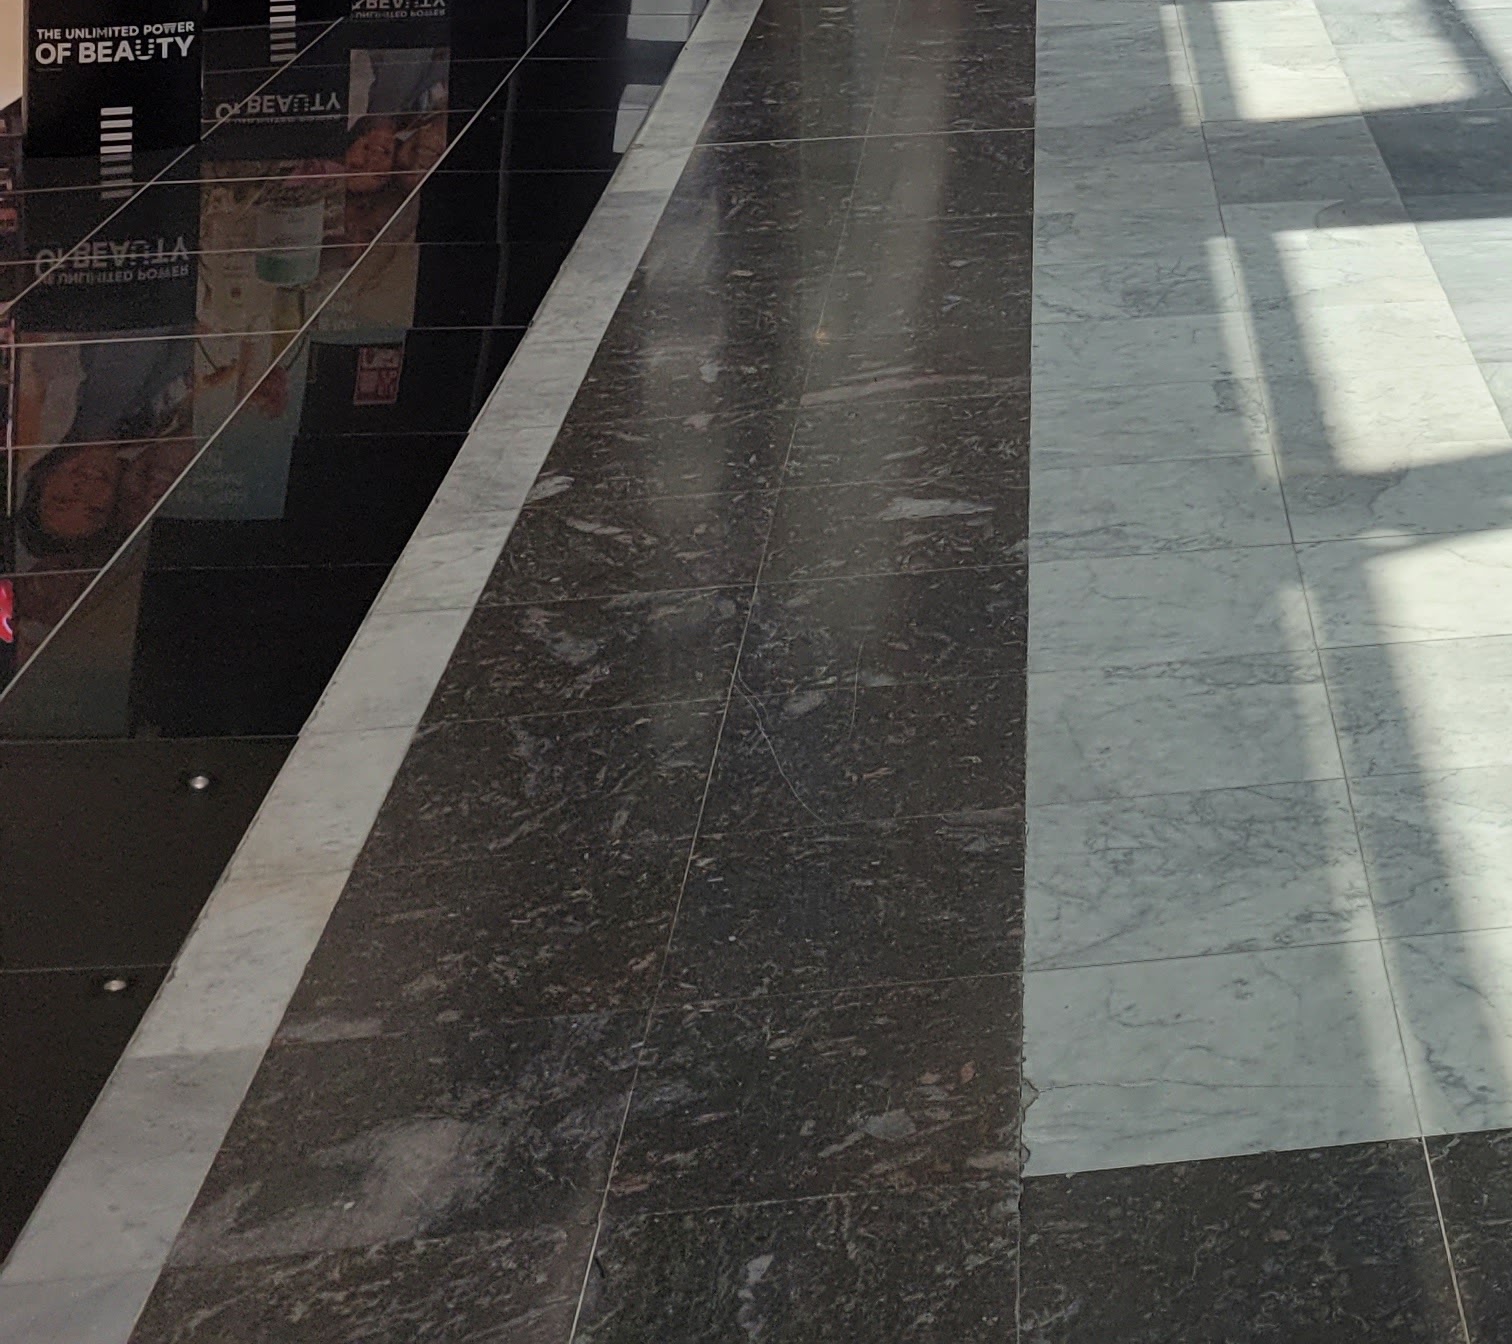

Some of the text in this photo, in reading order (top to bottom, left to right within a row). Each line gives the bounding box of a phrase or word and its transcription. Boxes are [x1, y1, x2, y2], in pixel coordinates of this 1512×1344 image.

[36, 21, 195, 40] THE UNLIMITED POWER
[35, 35, 195, 65] OF BEAUTY
